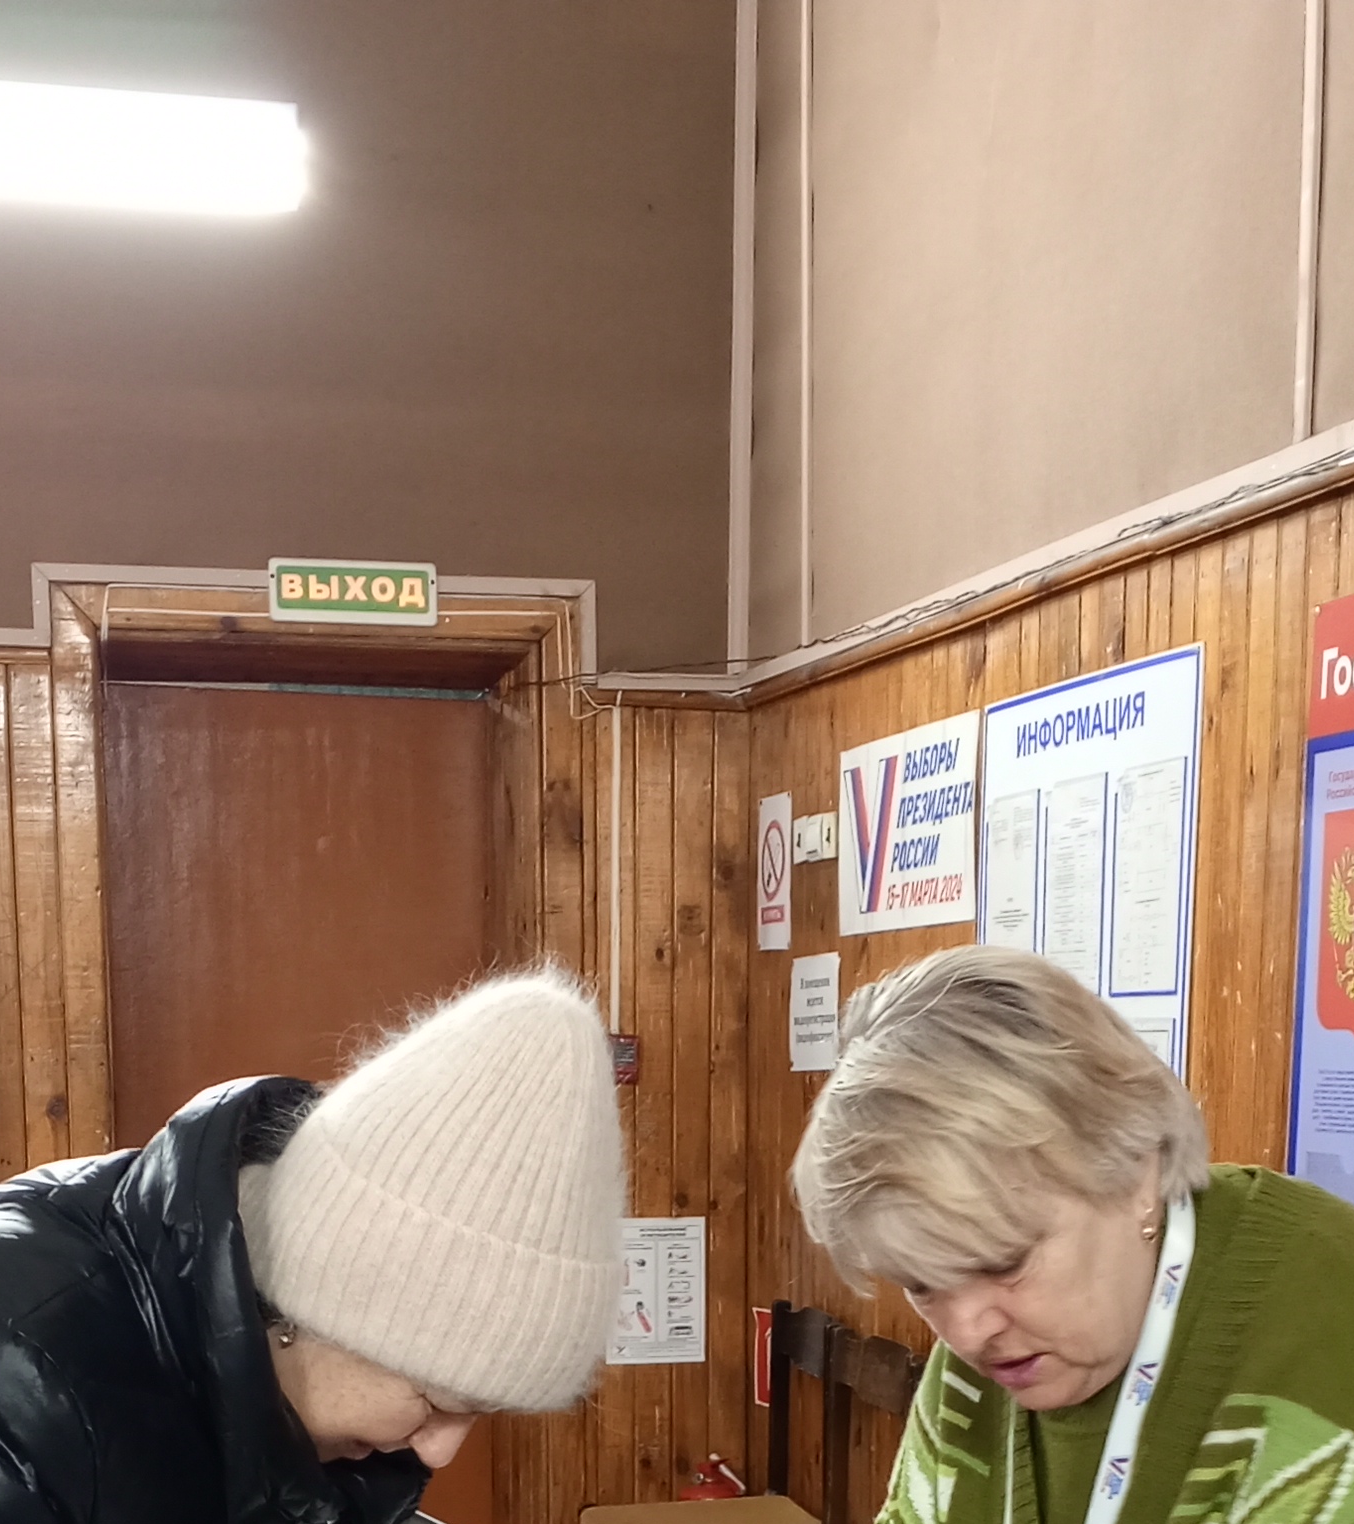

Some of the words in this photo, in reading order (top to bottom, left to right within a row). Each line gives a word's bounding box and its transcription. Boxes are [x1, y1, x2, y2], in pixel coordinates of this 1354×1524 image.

[280, 572, 426, 608] ВЫХОД
[1016, 690, 1145, 758] ИНФОРМАЦИЯ
[902, 738, 960, 784] ВЫБОРЫ
[896, 780, 974, 829] ПРЕЗИДЕНТА
[890, 834, 940, 873] РОССИИ
[908, 877, 939, 908] МАРТА
[939, 873, 963, 904] 2024
